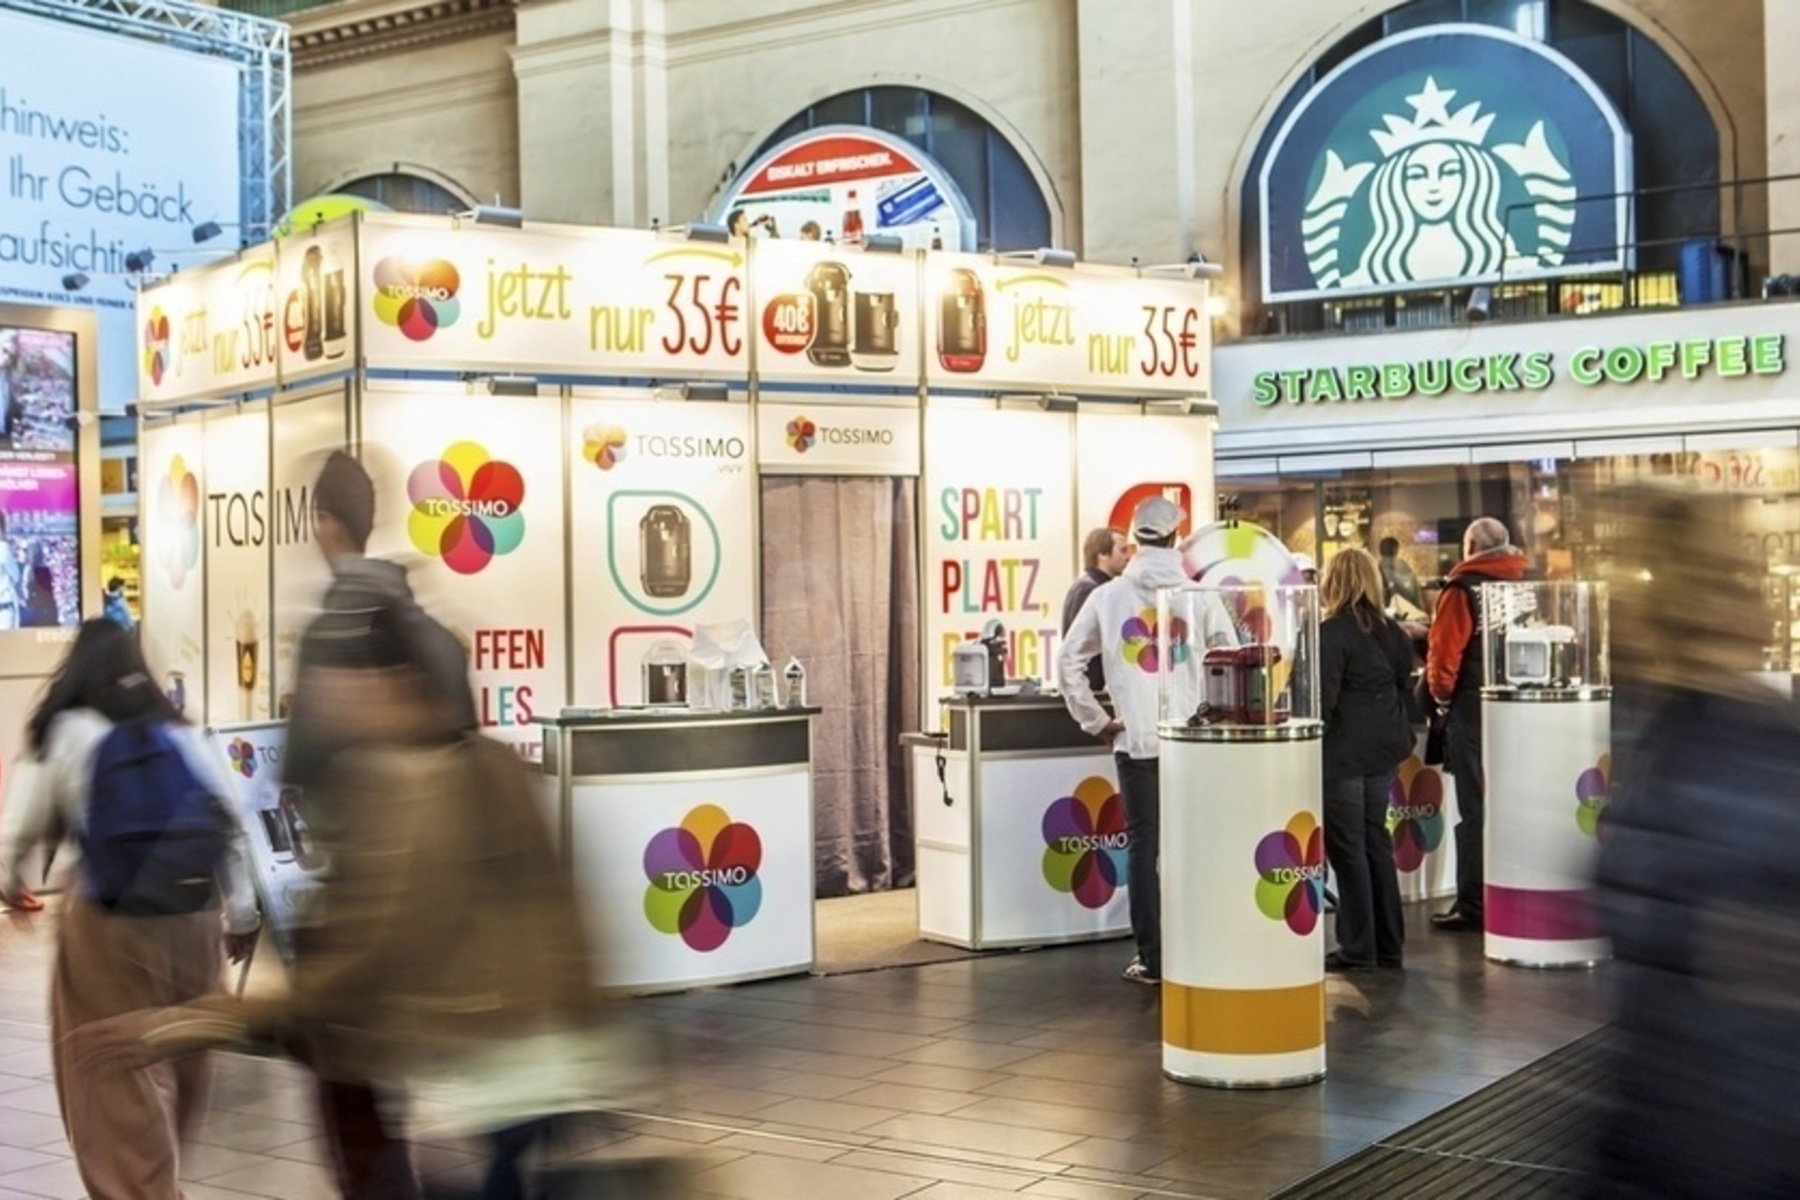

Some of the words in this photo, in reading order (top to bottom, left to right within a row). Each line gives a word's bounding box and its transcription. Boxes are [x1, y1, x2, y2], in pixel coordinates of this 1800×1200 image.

[0, 87, 129, 154] hinweis:
[9, 155, 49, 202] Ihr
[58, 164, 196, 224] Gebäck
[477, 258, 573, 340] jetzt
[590, 303, 655, 352] nur
[661, 273, 742, 357] 35€
[1006, 292, 1076, 363] jetzt
[1088, 332, 1136, 375] nur
[1140, 306, 1199, 377] 35€
[1253, 351, 1554, 407] STARBUCKS
[1569, 333, 1786, 385] COFFEE
[635, 436, 745, 459] TASSIMO
[820, 427, 894, 447] TASSIMO
[425, 498, 509, 517] TASSIMO
[940, 486, 1043, 541] SPART
[942, 558, 1049, 616] PLATZ,
[474, 629, 545, 671] FFEN
[481, 685, 533, 727] LES
[1386, 803, 1435, 821] ASSIMO
[1057, 830, 1130, 854] TASSIMO
[663, 865, 747, 890] TASSIMO
